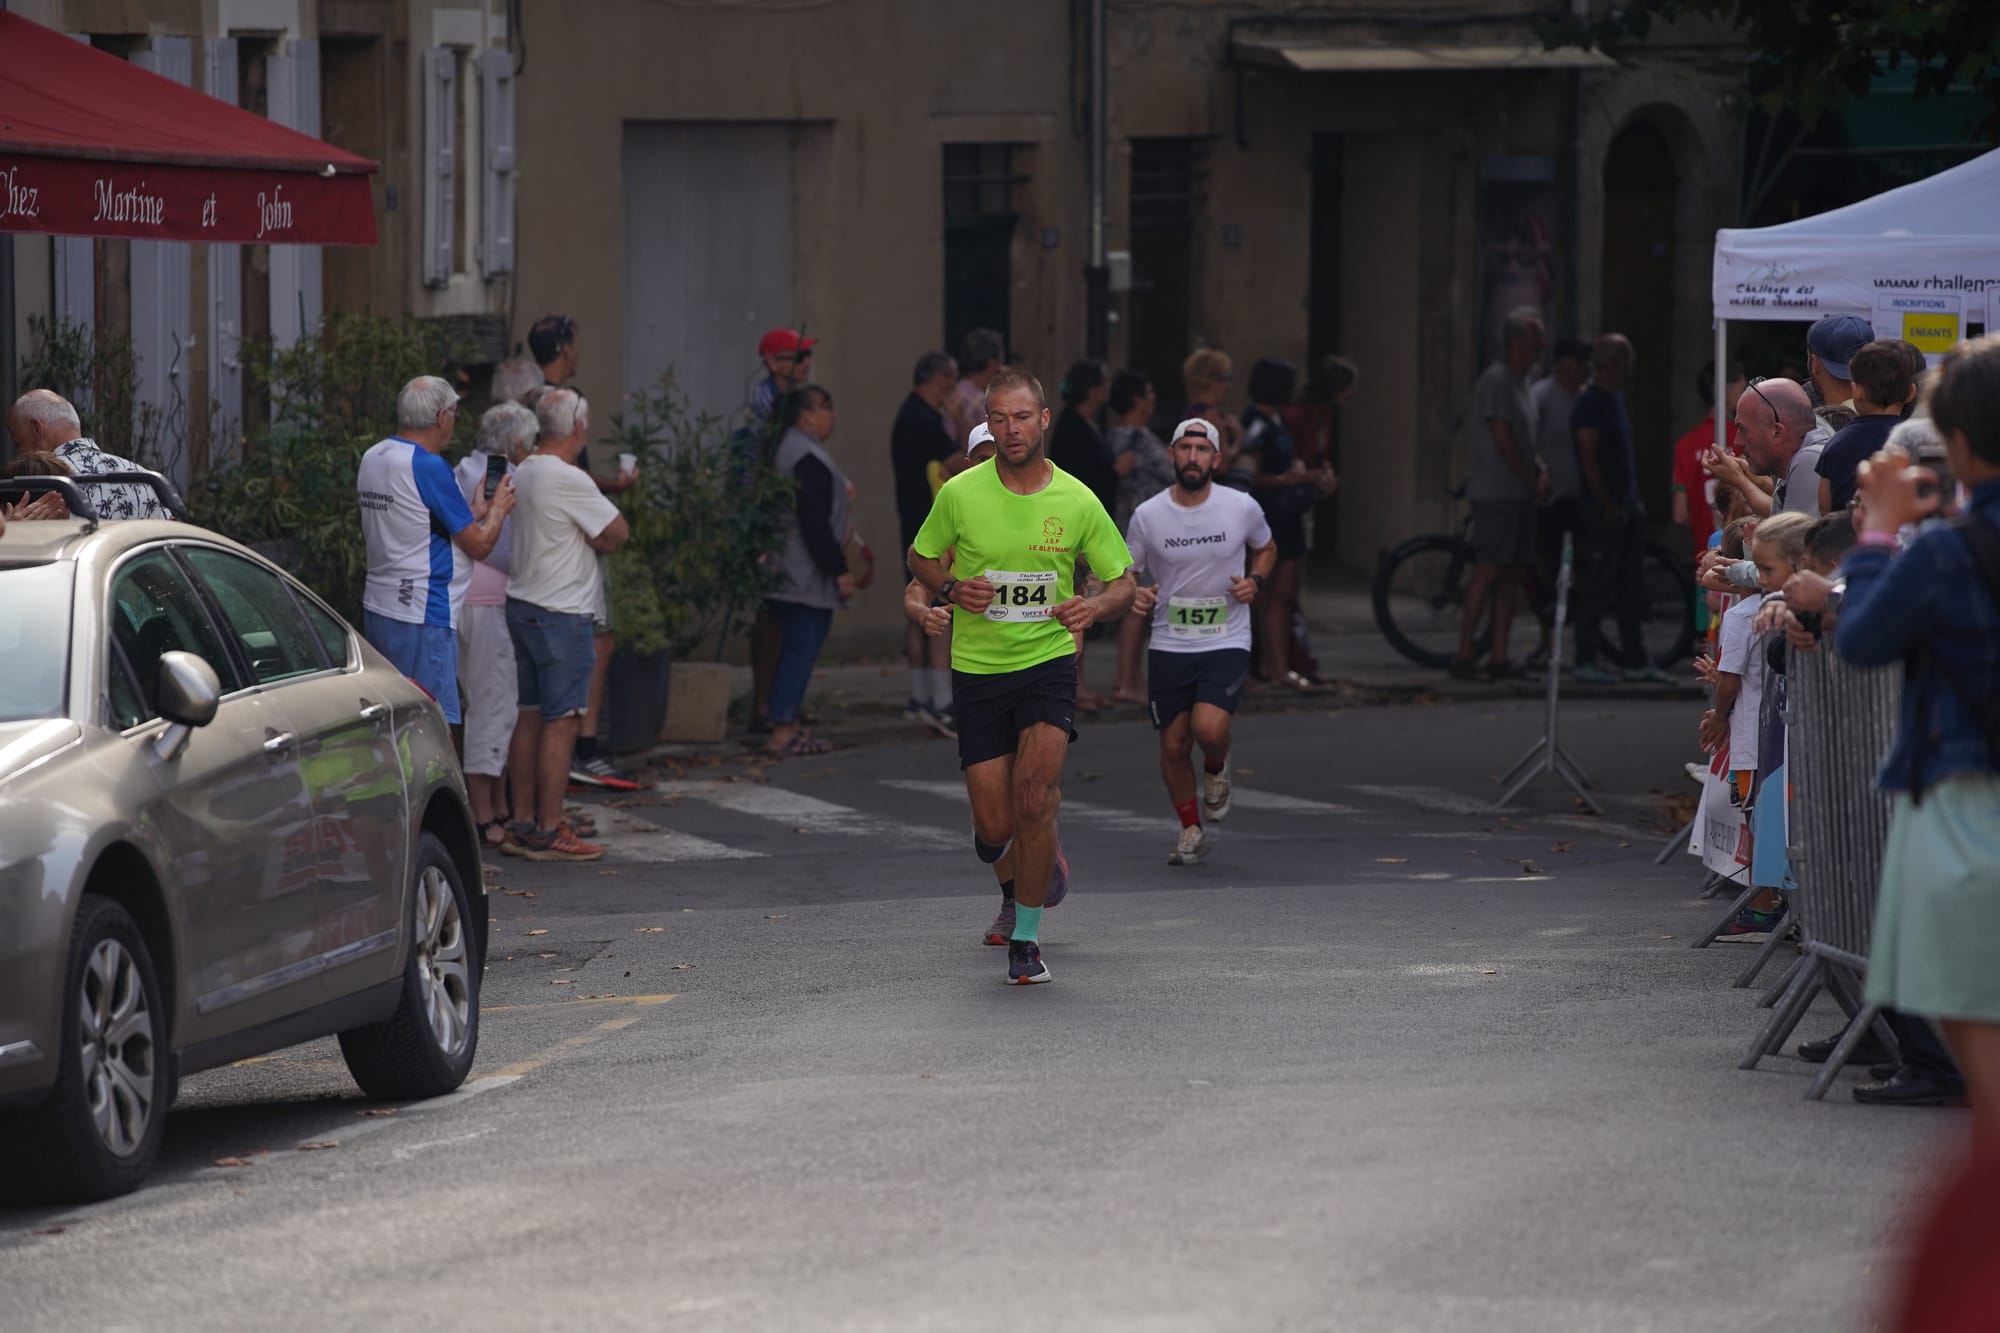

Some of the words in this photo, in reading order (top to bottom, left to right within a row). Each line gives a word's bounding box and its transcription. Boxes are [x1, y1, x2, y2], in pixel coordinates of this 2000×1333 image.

[93, 177, 165, 226] Martine
[201, 192, 218, 228] et
[256, 183, 294, 239] John
[1892, 298, 1946, 309] INSCRIPTIONS
[1909, 326, 1953, 339] ENFANTS
[996, 585, 1047, 606] 184
[1176, 607, 1219, 625] 157
